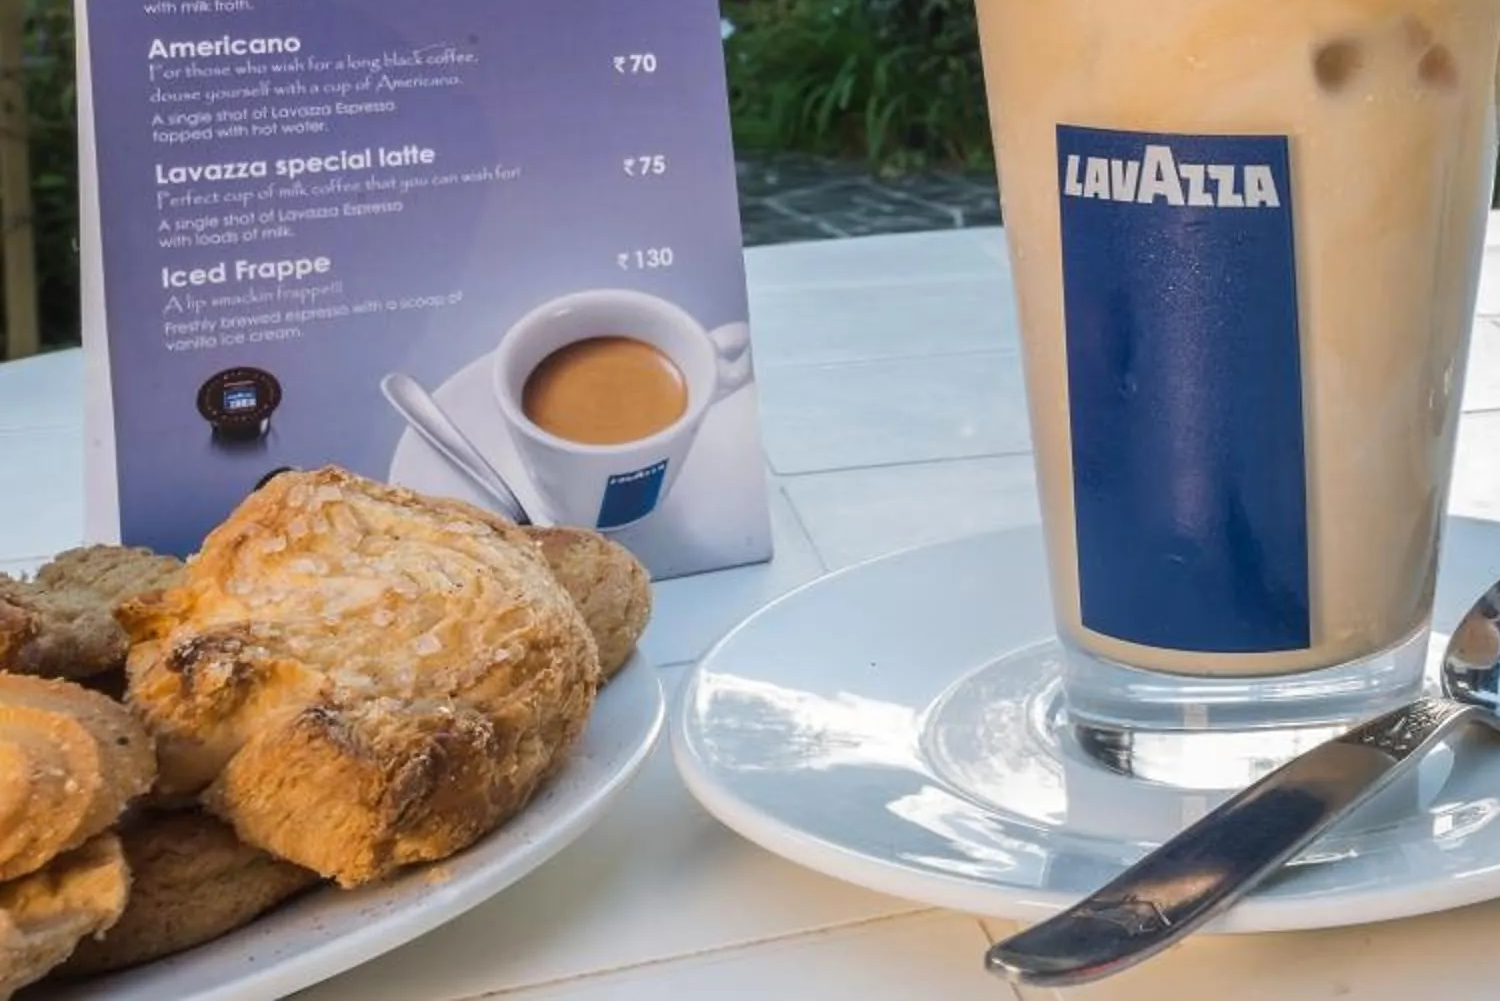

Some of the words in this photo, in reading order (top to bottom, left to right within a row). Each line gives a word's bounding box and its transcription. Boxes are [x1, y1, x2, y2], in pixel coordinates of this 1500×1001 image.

[144, 0, 177, 14] with
[181, 0, 210, 13] milk
[148, 35, 301, 59] Americano
[149, 63, 182, 82] For
[185, 61, 231, 78] those
[234, 60, 268, 75] who
[271, 56, 305, 72] wish
[307, 54, 332, 72] for
[335, 61, 345, 70] a
[347, 54, 383, 73] long
[205, 80, 270, 104] yourself
[273, 80, 307, 95] with
[309, 84, 320, 94] a
[323, 82, 351, 97] cup
[355, 76, 370, 92] of
[151, 113, 164, 126] A
[167, 110, 212, 127] single
[216, 108, 248, 121] shot
[252, 106, 268, 119] of
[271, 104, 332, 119] Lavazza
[335, 101, 396, 115] Espresso
[152, 128, 213, 144] topped
[216, 124, 249, 138] with
[251, 122, 277, 136] hot
[155, 160, 267, 184] Lavazza
[275, 148, 371, 179] special
[378, 144, 435, 167] latte
[1064, 144, 1281, 208] LAVAZZA
[157, 190, 219, 210] Perfect
[223, 192, 253, 207] cup
[258, 183, 274, 200] of
[279, 180, 307, 198] milk
[365, 175, 397, 191] that
[400, 178, 428, 193] you
[431, 175, 458, 186] can
[461, 167, 493, 182] wish
[158, 220, 171, 231] A
[174, 214, 219, 232] single
[223, 212, 254, 226] shot
[259, 209, 274, 223] of
[278, 207, 339, 222] Lavazza
[159, 233, 192, 248] with
[195, 230, 238, 246] loads
[243, 228, 258, 242] of
[162, 262, 226, 289] Iced
[235, 256, 331, 282] Frappe
[164, 295, 183, 315] A
[164, 320, 217, 337] Freshly
[220, 311, 281, 329] brewed
[165, 335, 217, 351] vanilla
[220, 332, 245, 346] ice
